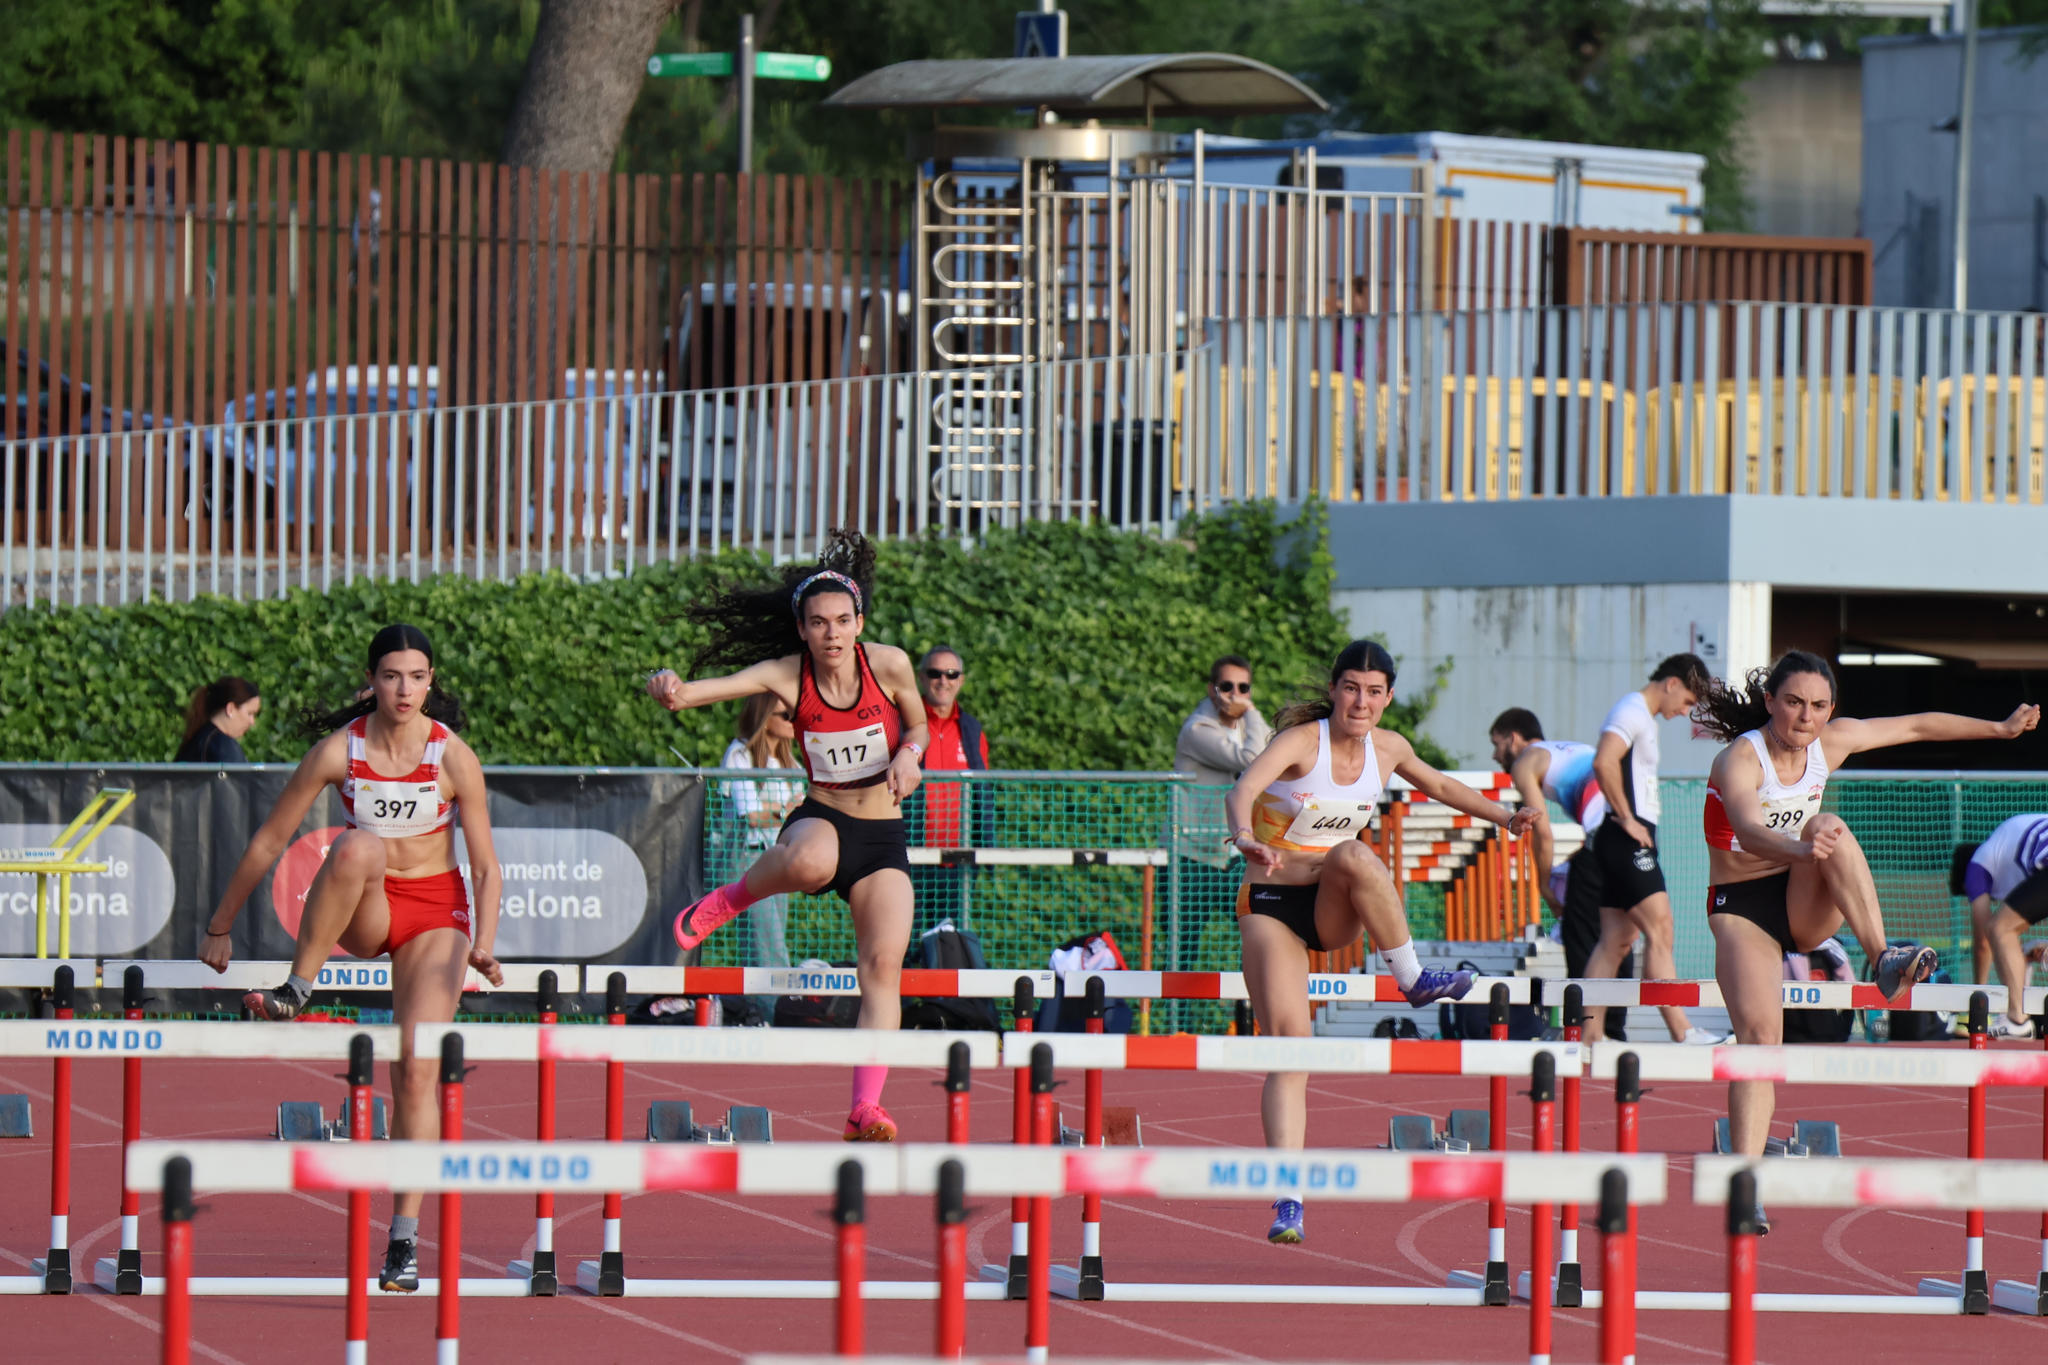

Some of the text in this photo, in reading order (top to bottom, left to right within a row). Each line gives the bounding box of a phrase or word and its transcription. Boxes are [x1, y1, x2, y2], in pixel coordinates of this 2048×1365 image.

[827, 744, 867, 765] 117
[374, 798, 417, 819] 397
[1311, 816, 1351, 830] 440
[1765, 810, 1804, 829] 399
[573, 859, 602, 881] de
[498, 888, 602, 919] elona
[317, 968, 388, 985] ONDO
[787, 974, 856, 990] MOND
[1308, 979, 1347, 995] NDO
[46, 1029, 162, 1050] MONDO
[440, 1155, 590, 1180] MONDO
[1210, 1161, 1357, 1189] MONDO
